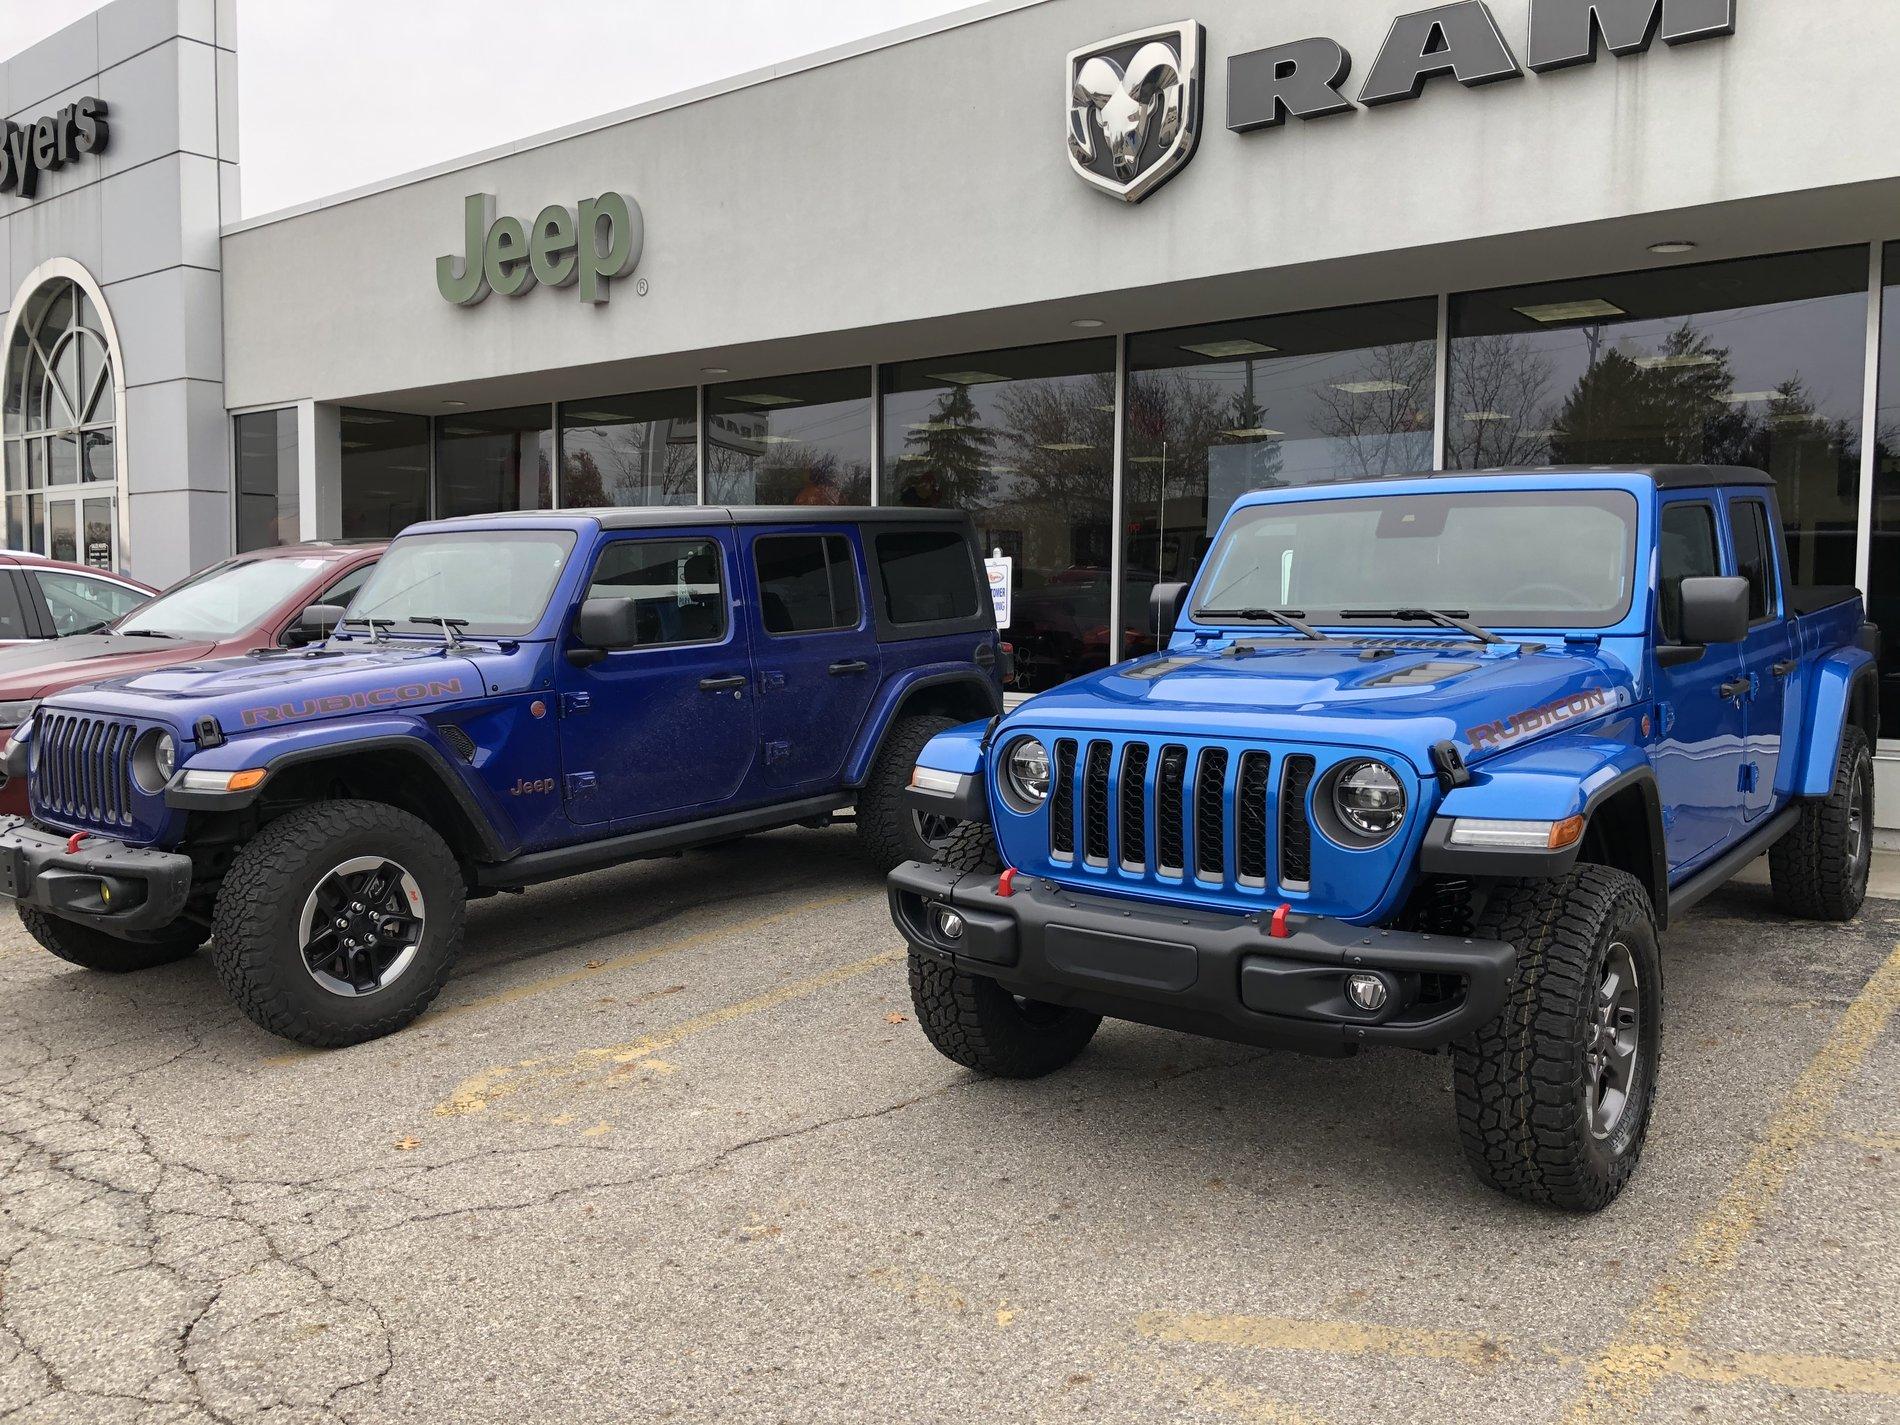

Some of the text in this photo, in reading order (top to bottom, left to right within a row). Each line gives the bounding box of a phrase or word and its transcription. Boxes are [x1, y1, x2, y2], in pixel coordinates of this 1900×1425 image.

[1226, 0, 1736, 133] RAM
[0, 96, 109, 199] yers
[436, 191, 645, 305] Jeep
[240, 678, 464, 727] RUBICON
[1465, 685, 1606, 751] RUBICON
[510, 775, 555, 797] Jeep
